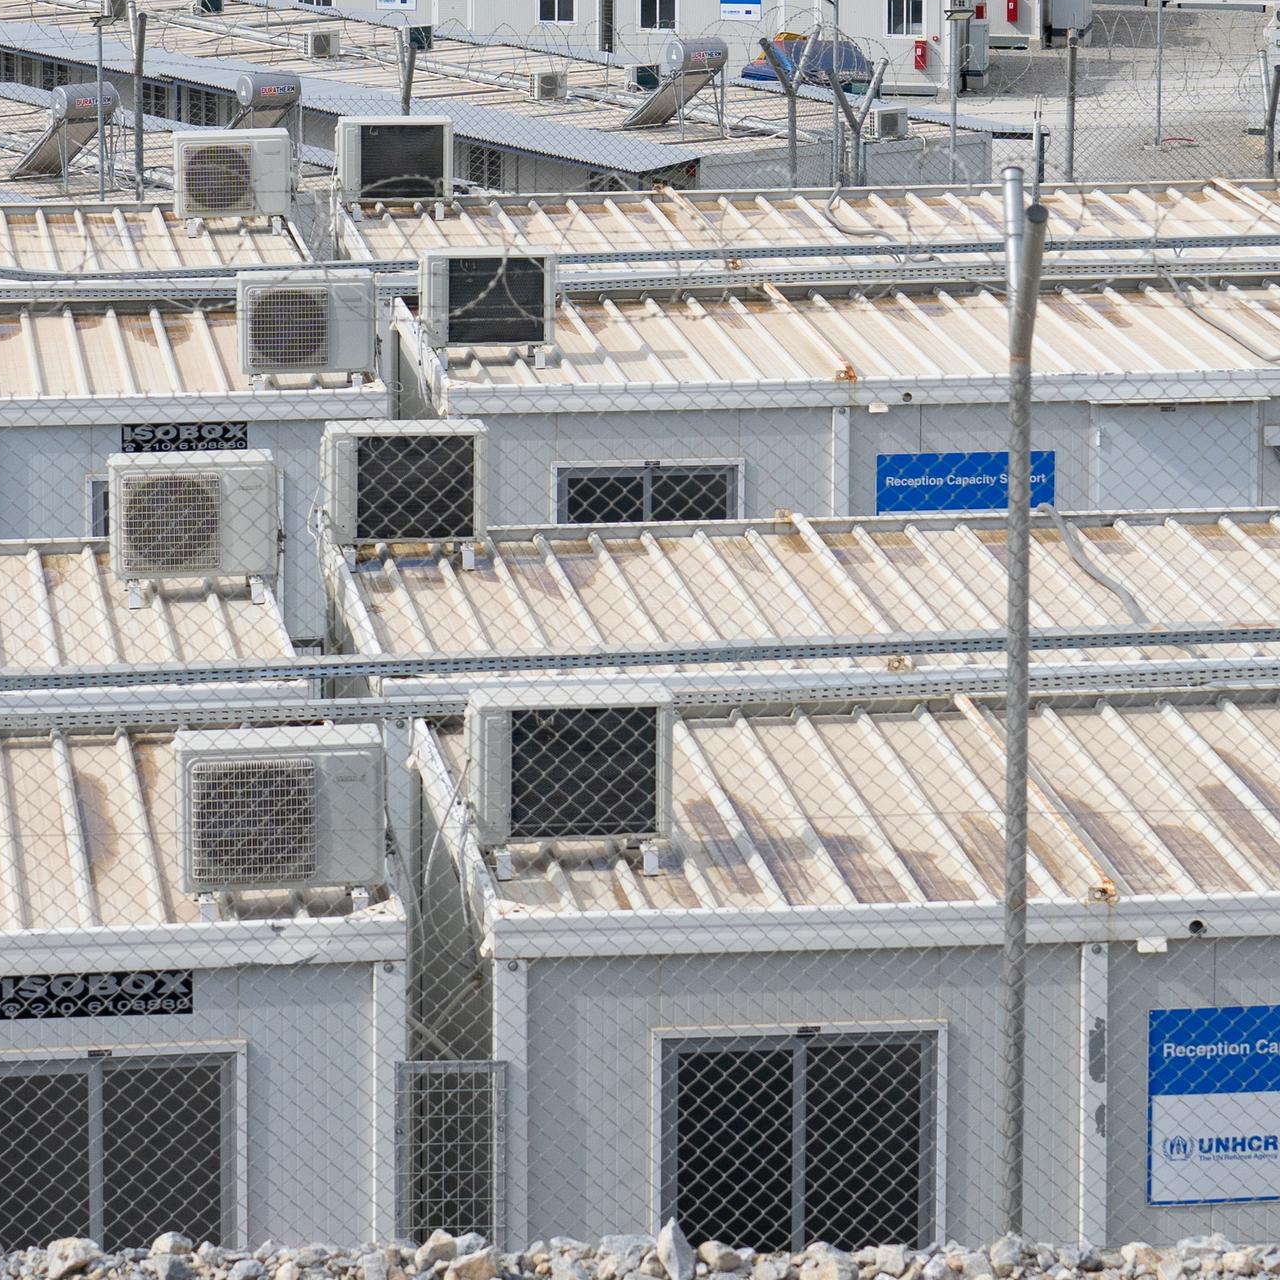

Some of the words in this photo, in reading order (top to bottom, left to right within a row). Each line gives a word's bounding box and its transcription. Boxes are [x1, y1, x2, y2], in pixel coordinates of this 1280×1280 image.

[123, 423, 245, 441] ISOBOX
[142, 443, 170, 451] 210
[886, 476, 944, 488] Reception
[946, 474, 997, 487] Capacity
[1000, 473, 1046, 484] Sort
[1, 973, 190, 998] ISOBOX
[31, 1001, 73, 1015] 210
[88, 998, 190, 1013] 6108880
[1163, 1041, 1250, 1059] Reception
[1199, 1135, 1278, 1153] UNHCR
